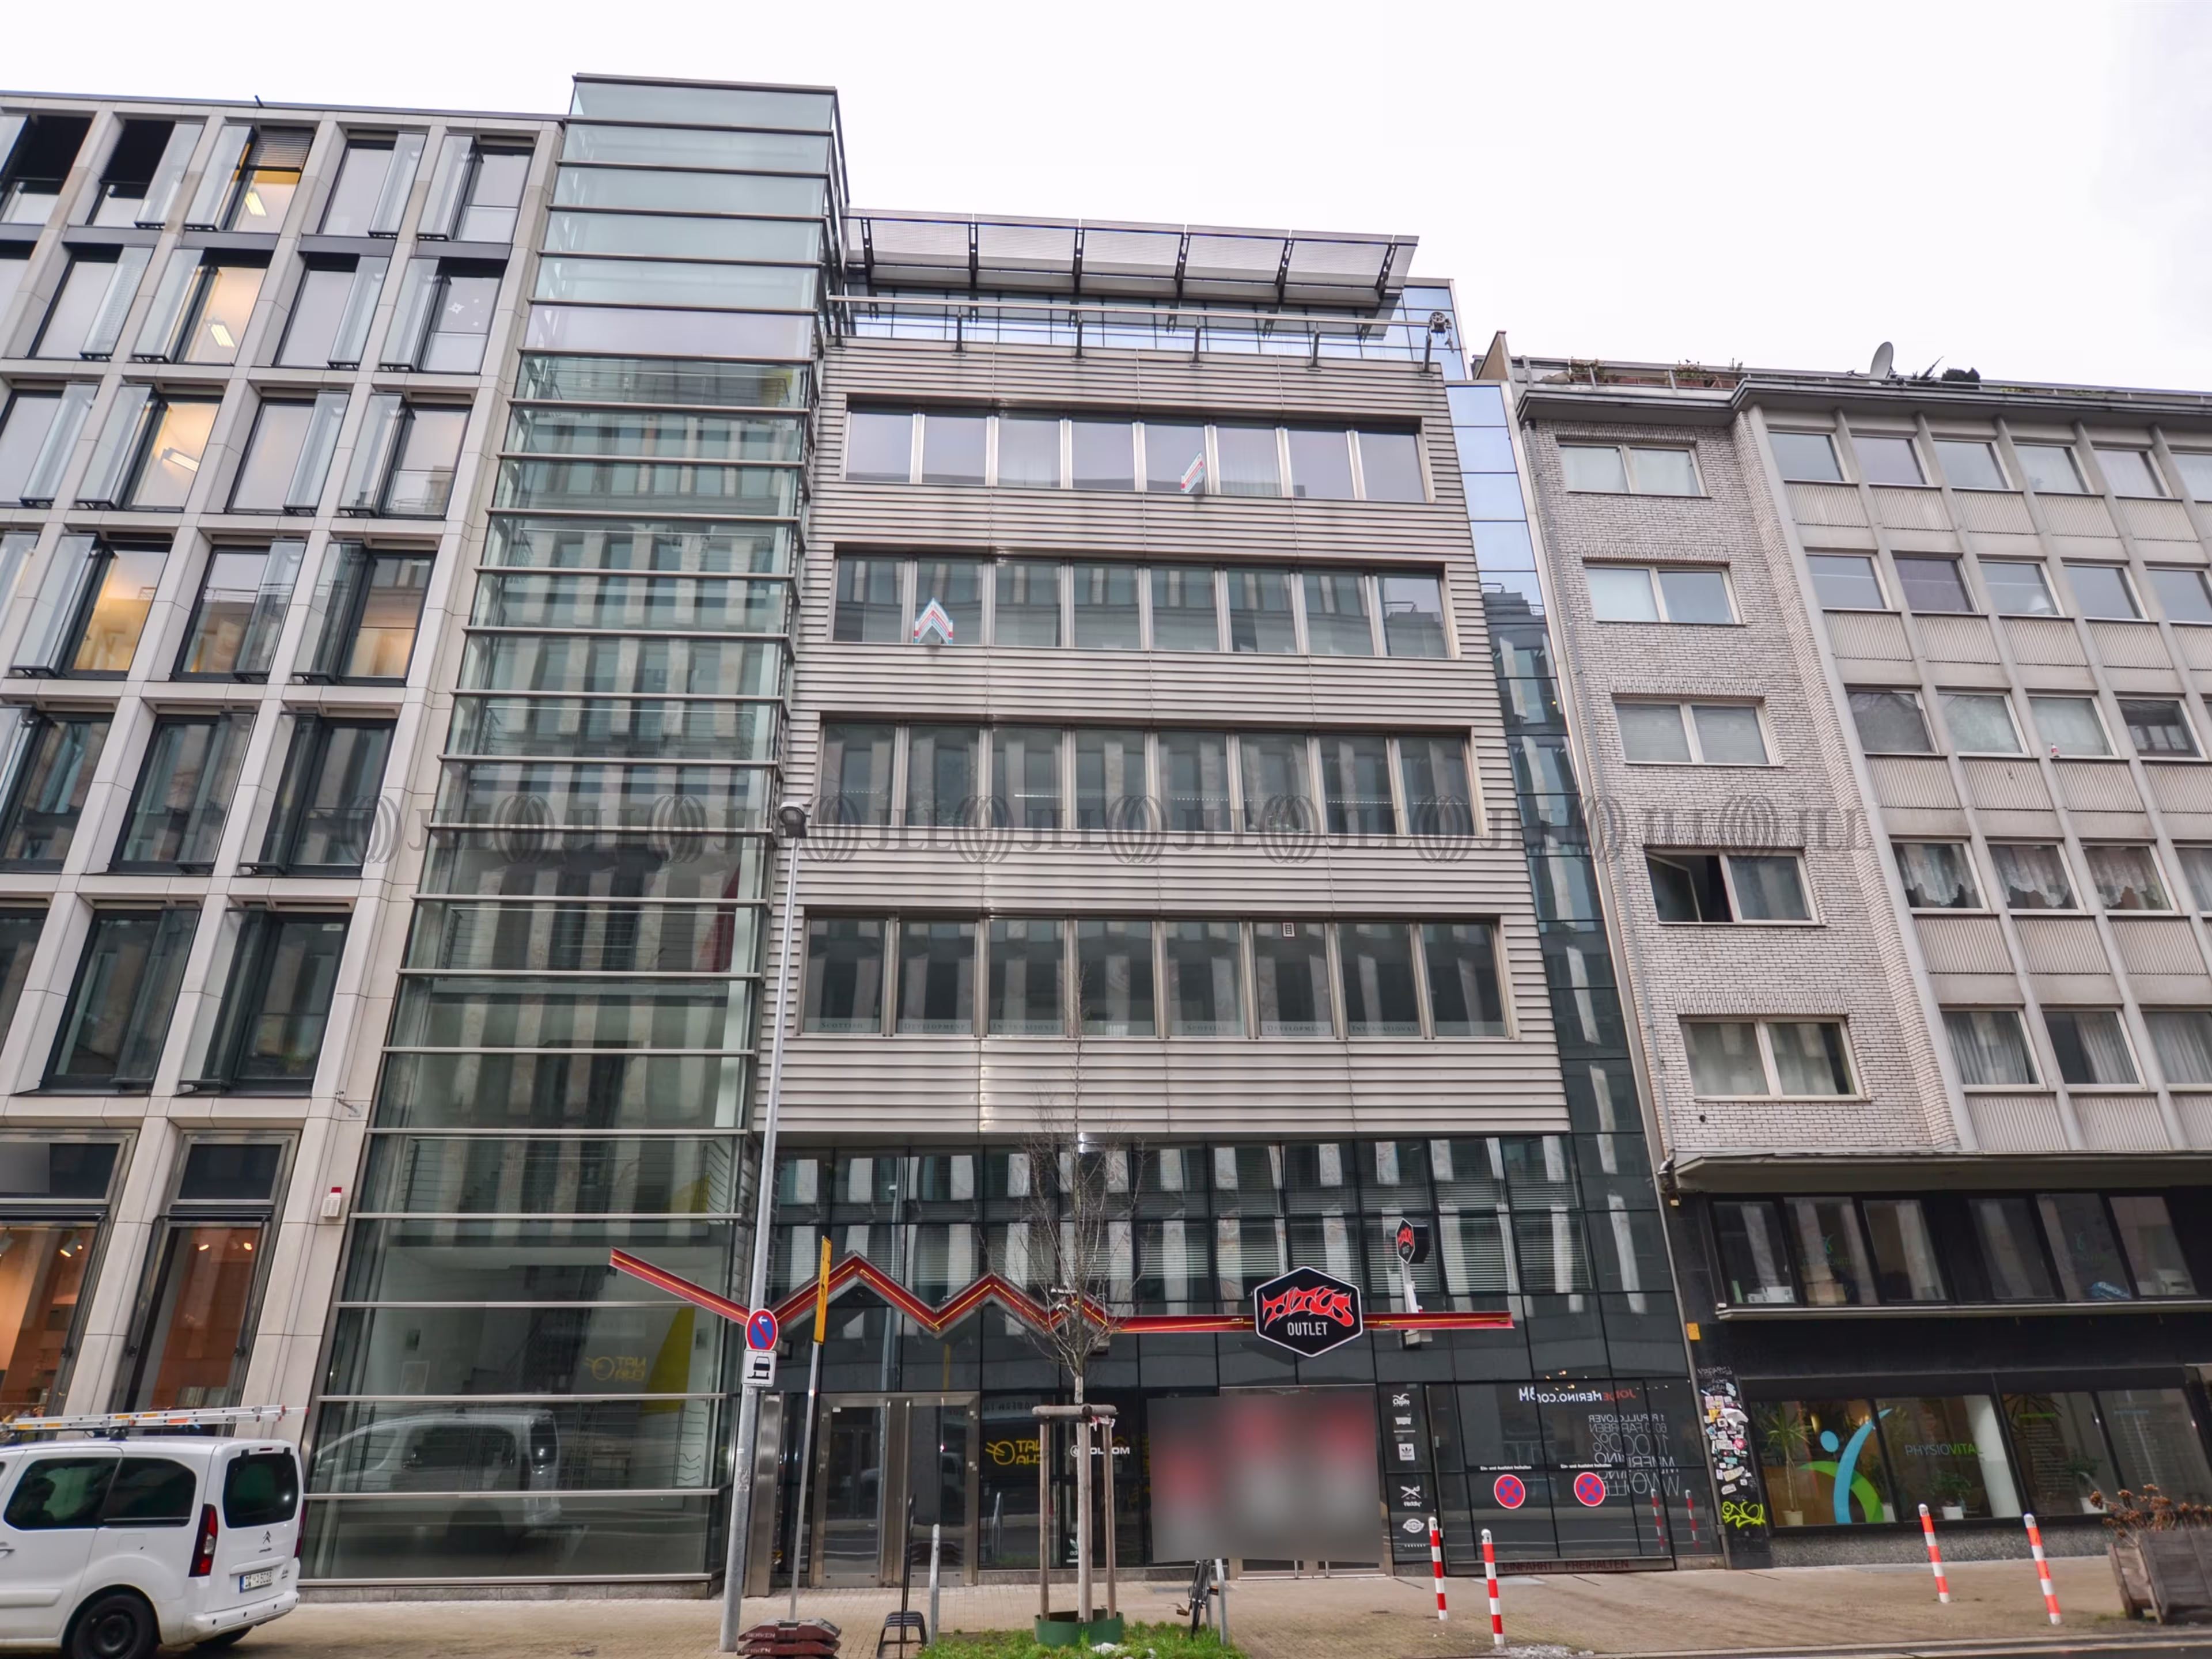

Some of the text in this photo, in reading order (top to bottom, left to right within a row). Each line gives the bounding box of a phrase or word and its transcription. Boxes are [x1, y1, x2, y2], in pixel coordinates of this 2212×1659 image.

[1287, 1322, 1328, 1336] OUTLET
[1904, 1442, 1984, 1456] PHYSIOVITAL
[1502, 1559, 1629, 1572] EINFAHRT FREIHALTEN
